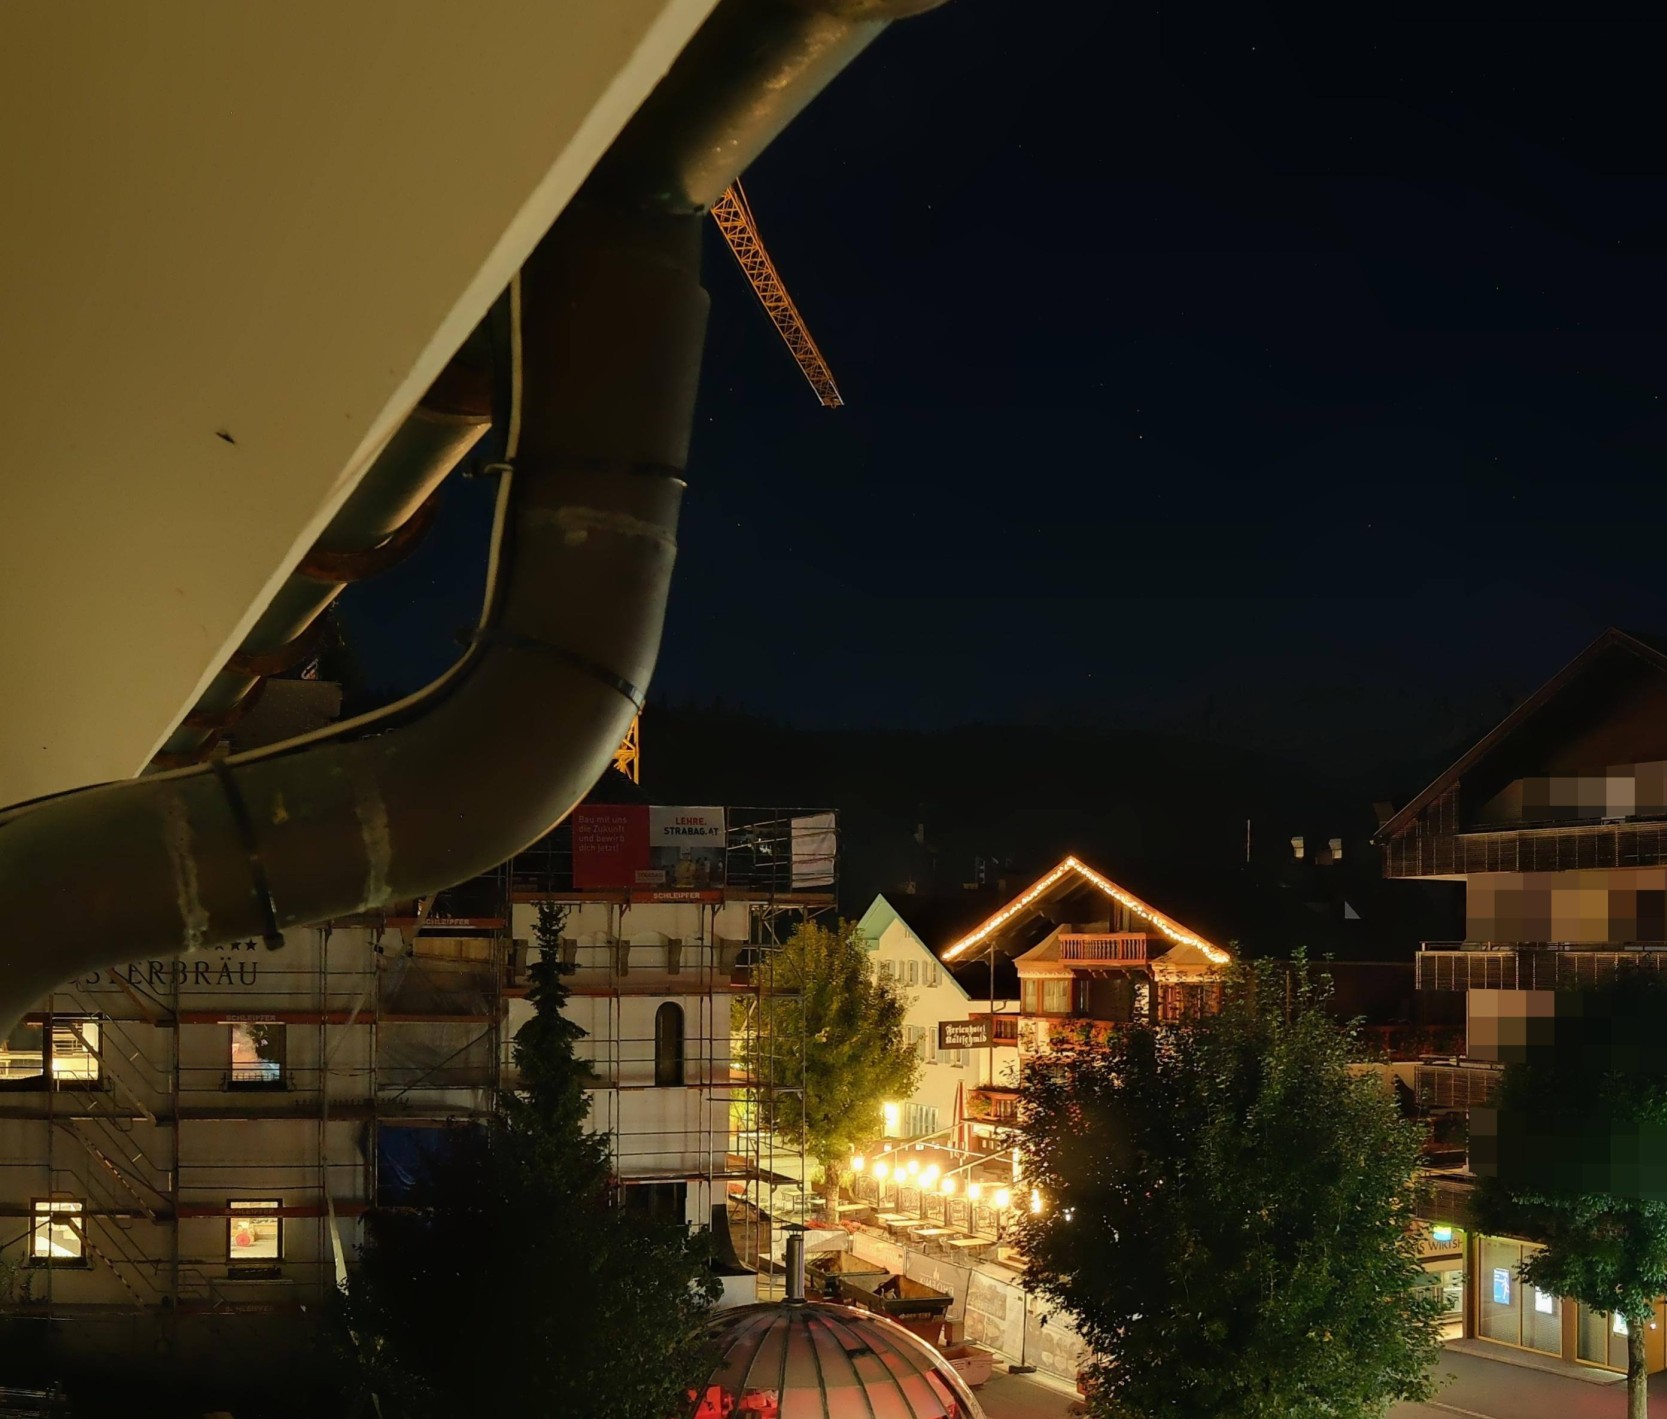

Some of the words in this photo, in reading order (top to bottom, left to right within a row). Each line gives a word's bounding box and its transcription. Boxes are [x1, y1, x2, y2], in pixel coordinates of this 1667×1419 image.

[675, 817, 707, 826] LEHRE.
[664, 826, 720, 836] STRABAG.AT
[653, 892, 701, 900] SCHLEIPFER
